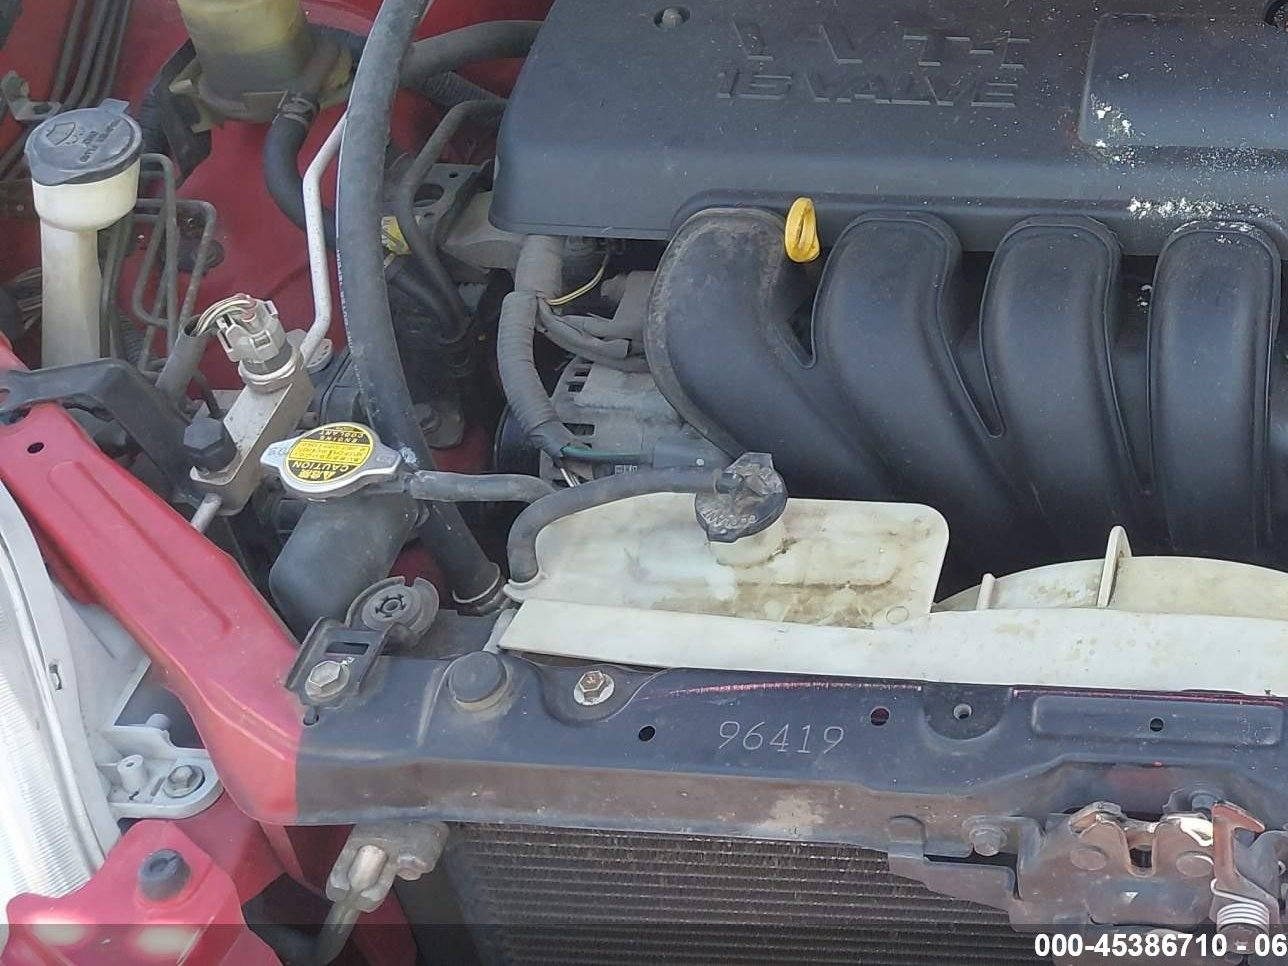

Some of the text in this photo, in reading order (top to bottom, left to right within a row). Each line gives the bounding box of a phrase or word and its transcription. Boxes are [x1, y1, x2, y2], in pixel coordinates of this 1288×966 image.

[319, 429, 364, 439] COOLANT
[292, 460, 350, 473] CAUTION
[718, 720, 846, 755] 96419
